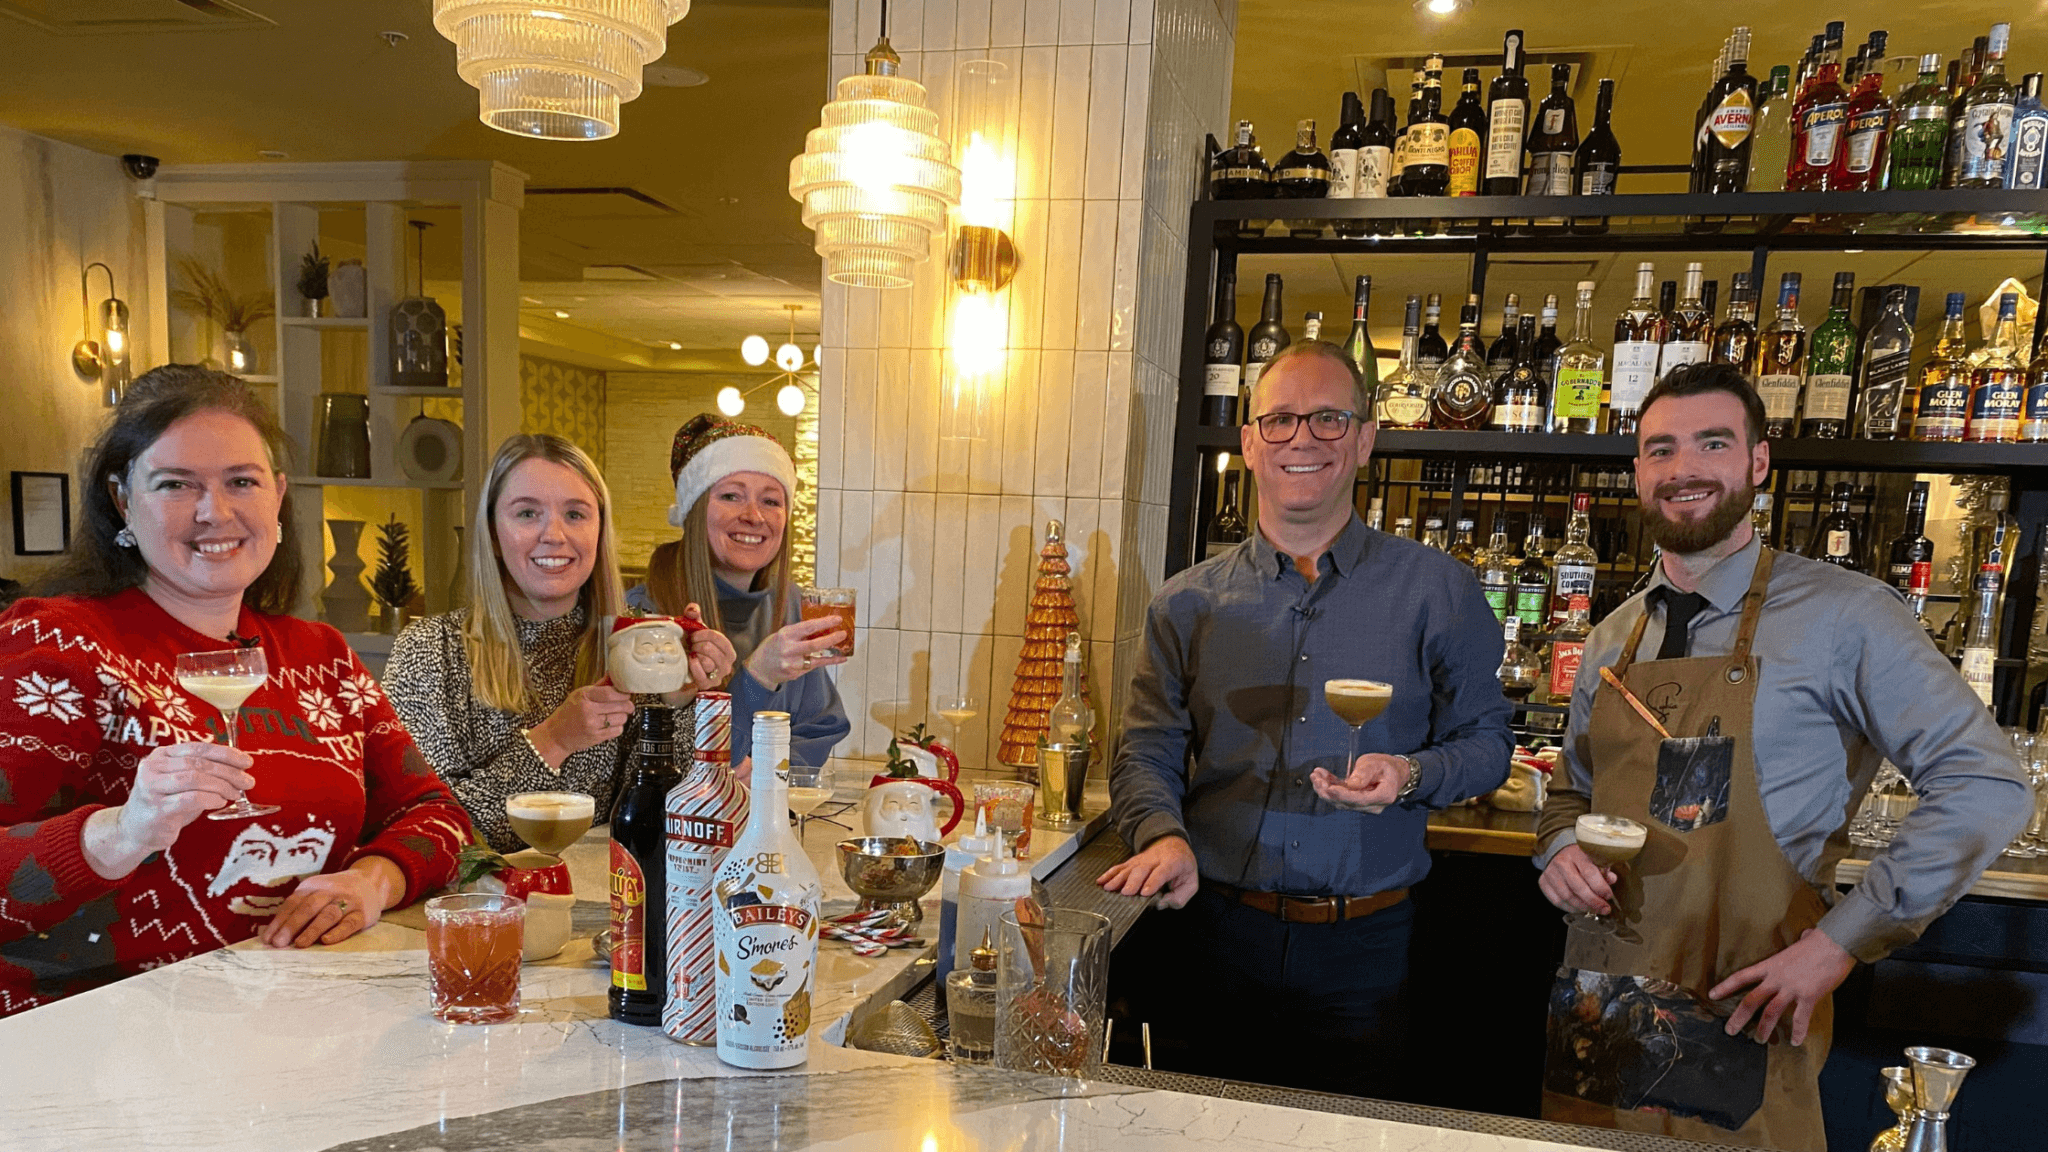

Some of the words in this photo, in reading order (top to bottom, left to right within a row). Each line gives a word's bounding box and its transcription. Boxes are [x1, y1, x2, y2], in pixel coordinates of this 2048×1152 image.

[1805, 108, 1844, 128] APEROL
[1848, 116, 1884, 133] APEROL
[1869, 365, 1889, 376] BLACK
[1890, 360, 1910, 369] LABEL
[1209, 372, 1220, 381] 20
[1628, 374, 1639, 383] 12
[1936, 390, 1963, 399] GLEN
[1991, 391, 2018, 400] GLEN
[1929, 398, 1965, 407] MORAY
[1984, 399, 2020, 408] MORAY
[735, 907, 806, 926] BAILEYS
[737, 935, 799, 960] S'mores
